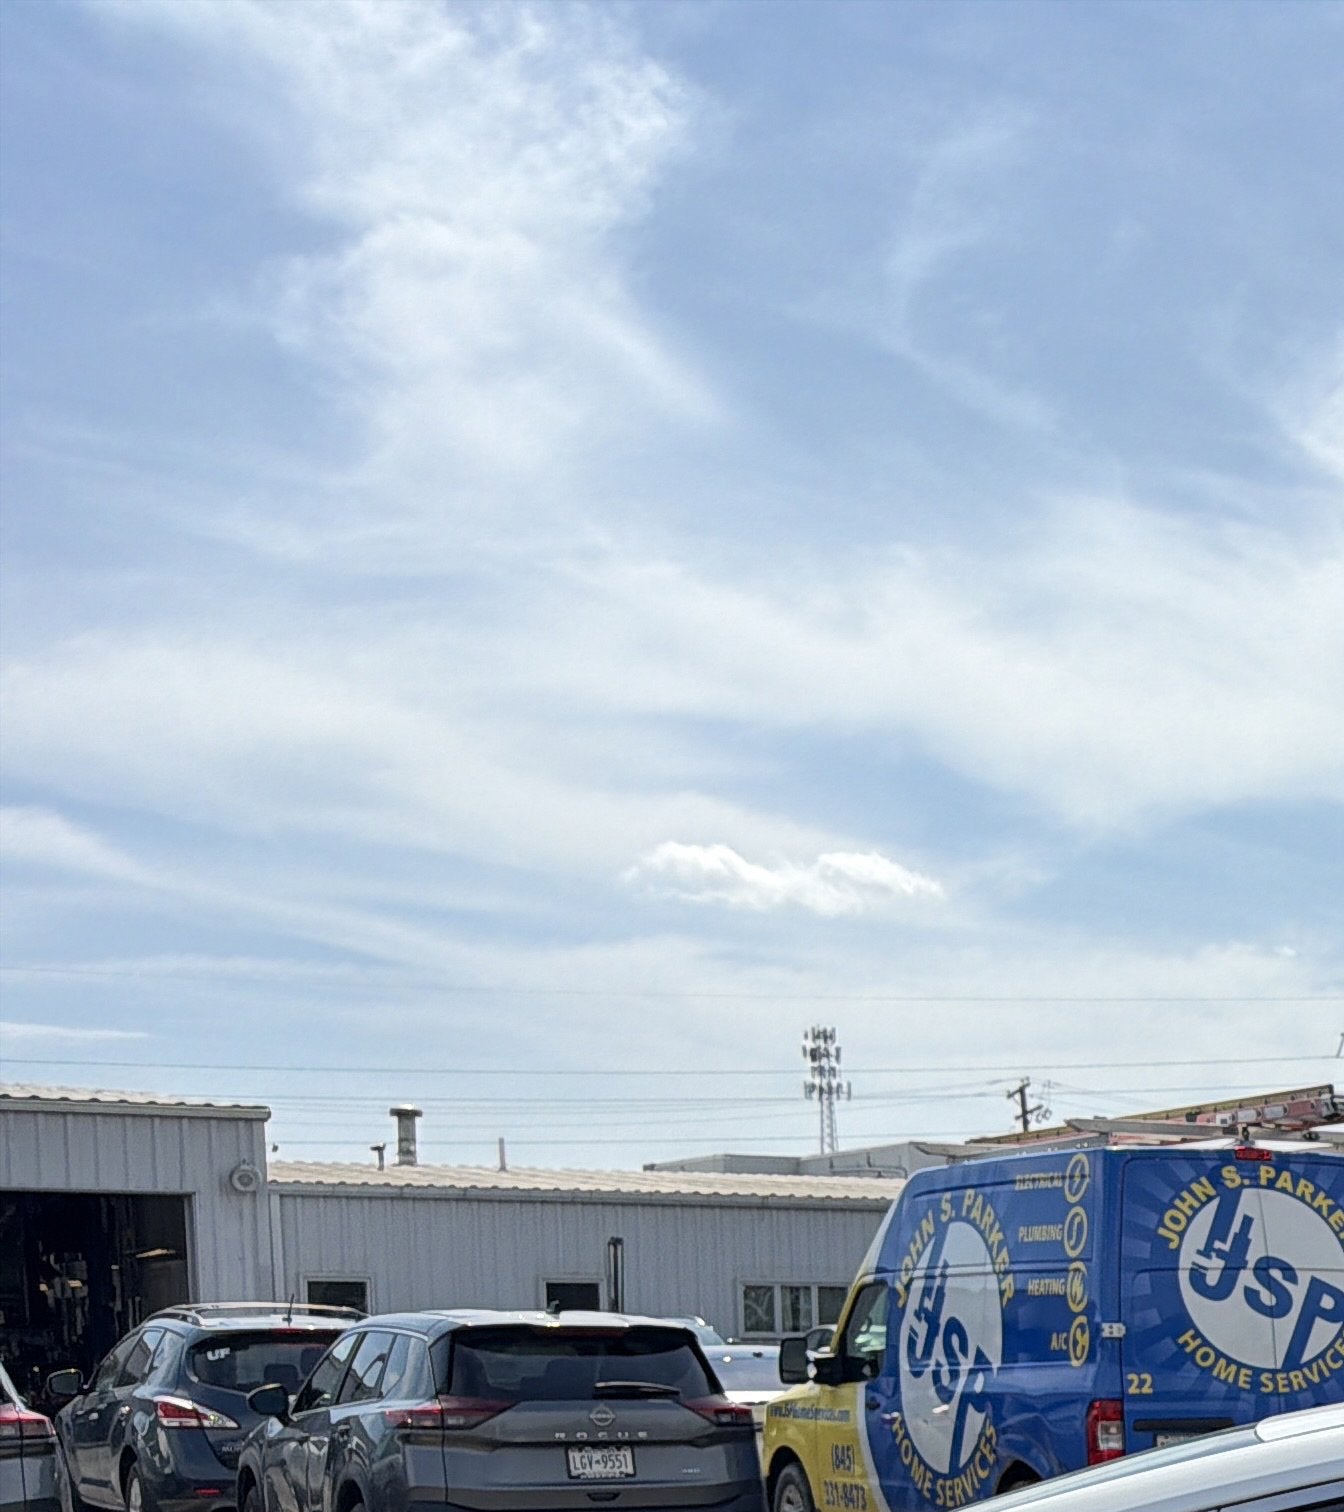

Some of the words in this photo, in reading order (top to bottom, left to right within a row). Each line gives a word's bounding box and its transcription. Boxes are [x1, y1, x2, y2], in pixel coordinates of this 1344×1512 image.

[1157, 1176, 1217, 1250] JOHN
[1222, 1165, 1250, 1188] S.
[1018, 1224, 1063, 1243] PLUMBING
[895, 1210, 935, 1309] JOHN
[940, 1192, 956, 1223] S.
[962, 1188, 1015, 1308] PARKER
[1028, 1279, 1066, 1296] HEATING
[1050, 1332, 1068, 1350] A/C
[1177, 1329, 1253, 1389] HOME
[1126, 1373, 1153, 1395] 22
[555, 1431, 648, 1440] ROGUE
[832, 1442, 855, 1475] (845)
[892, 1415, 933, 1498] HOME
[936, 1418, 997, 1507] SERVICES
